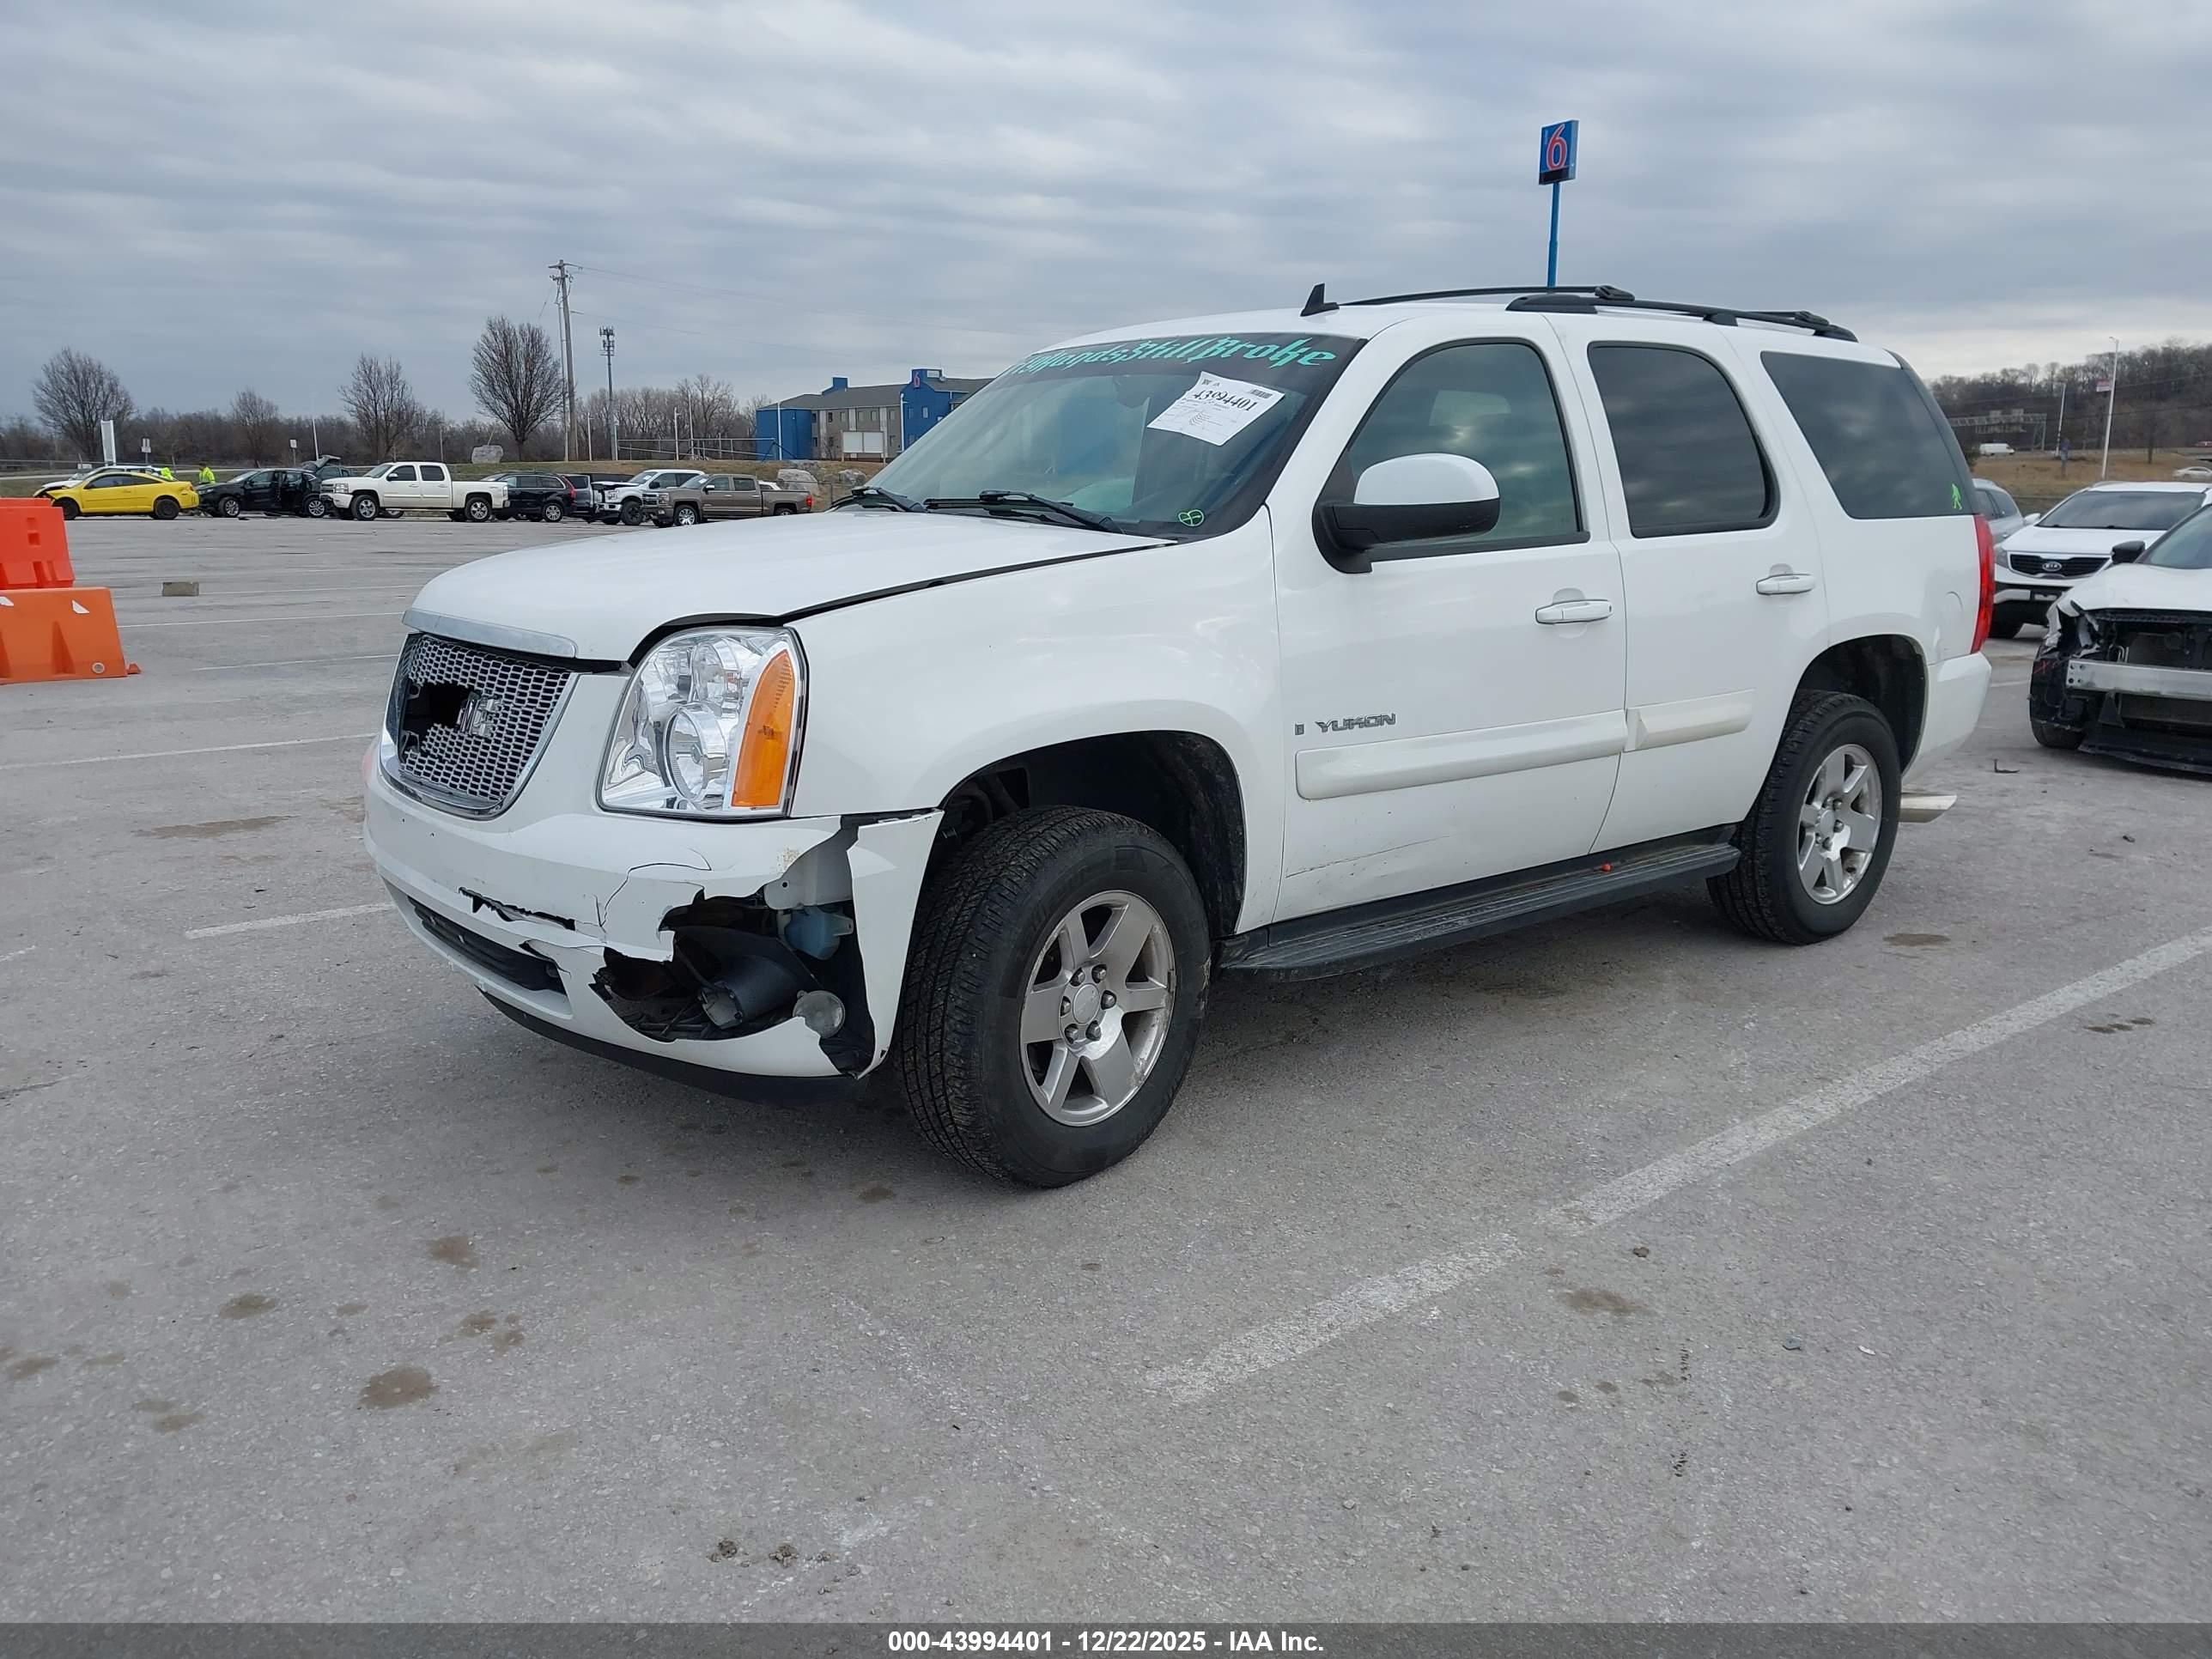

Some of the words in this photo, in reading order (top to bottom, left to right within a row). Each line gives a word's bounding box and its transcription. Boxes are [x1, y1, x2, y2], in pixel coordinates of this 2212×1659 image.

[1546, 124, 1568, 171] 6
[913, 371, 921, 388] 6
[1315, 713, 1396, 732] YUKON
